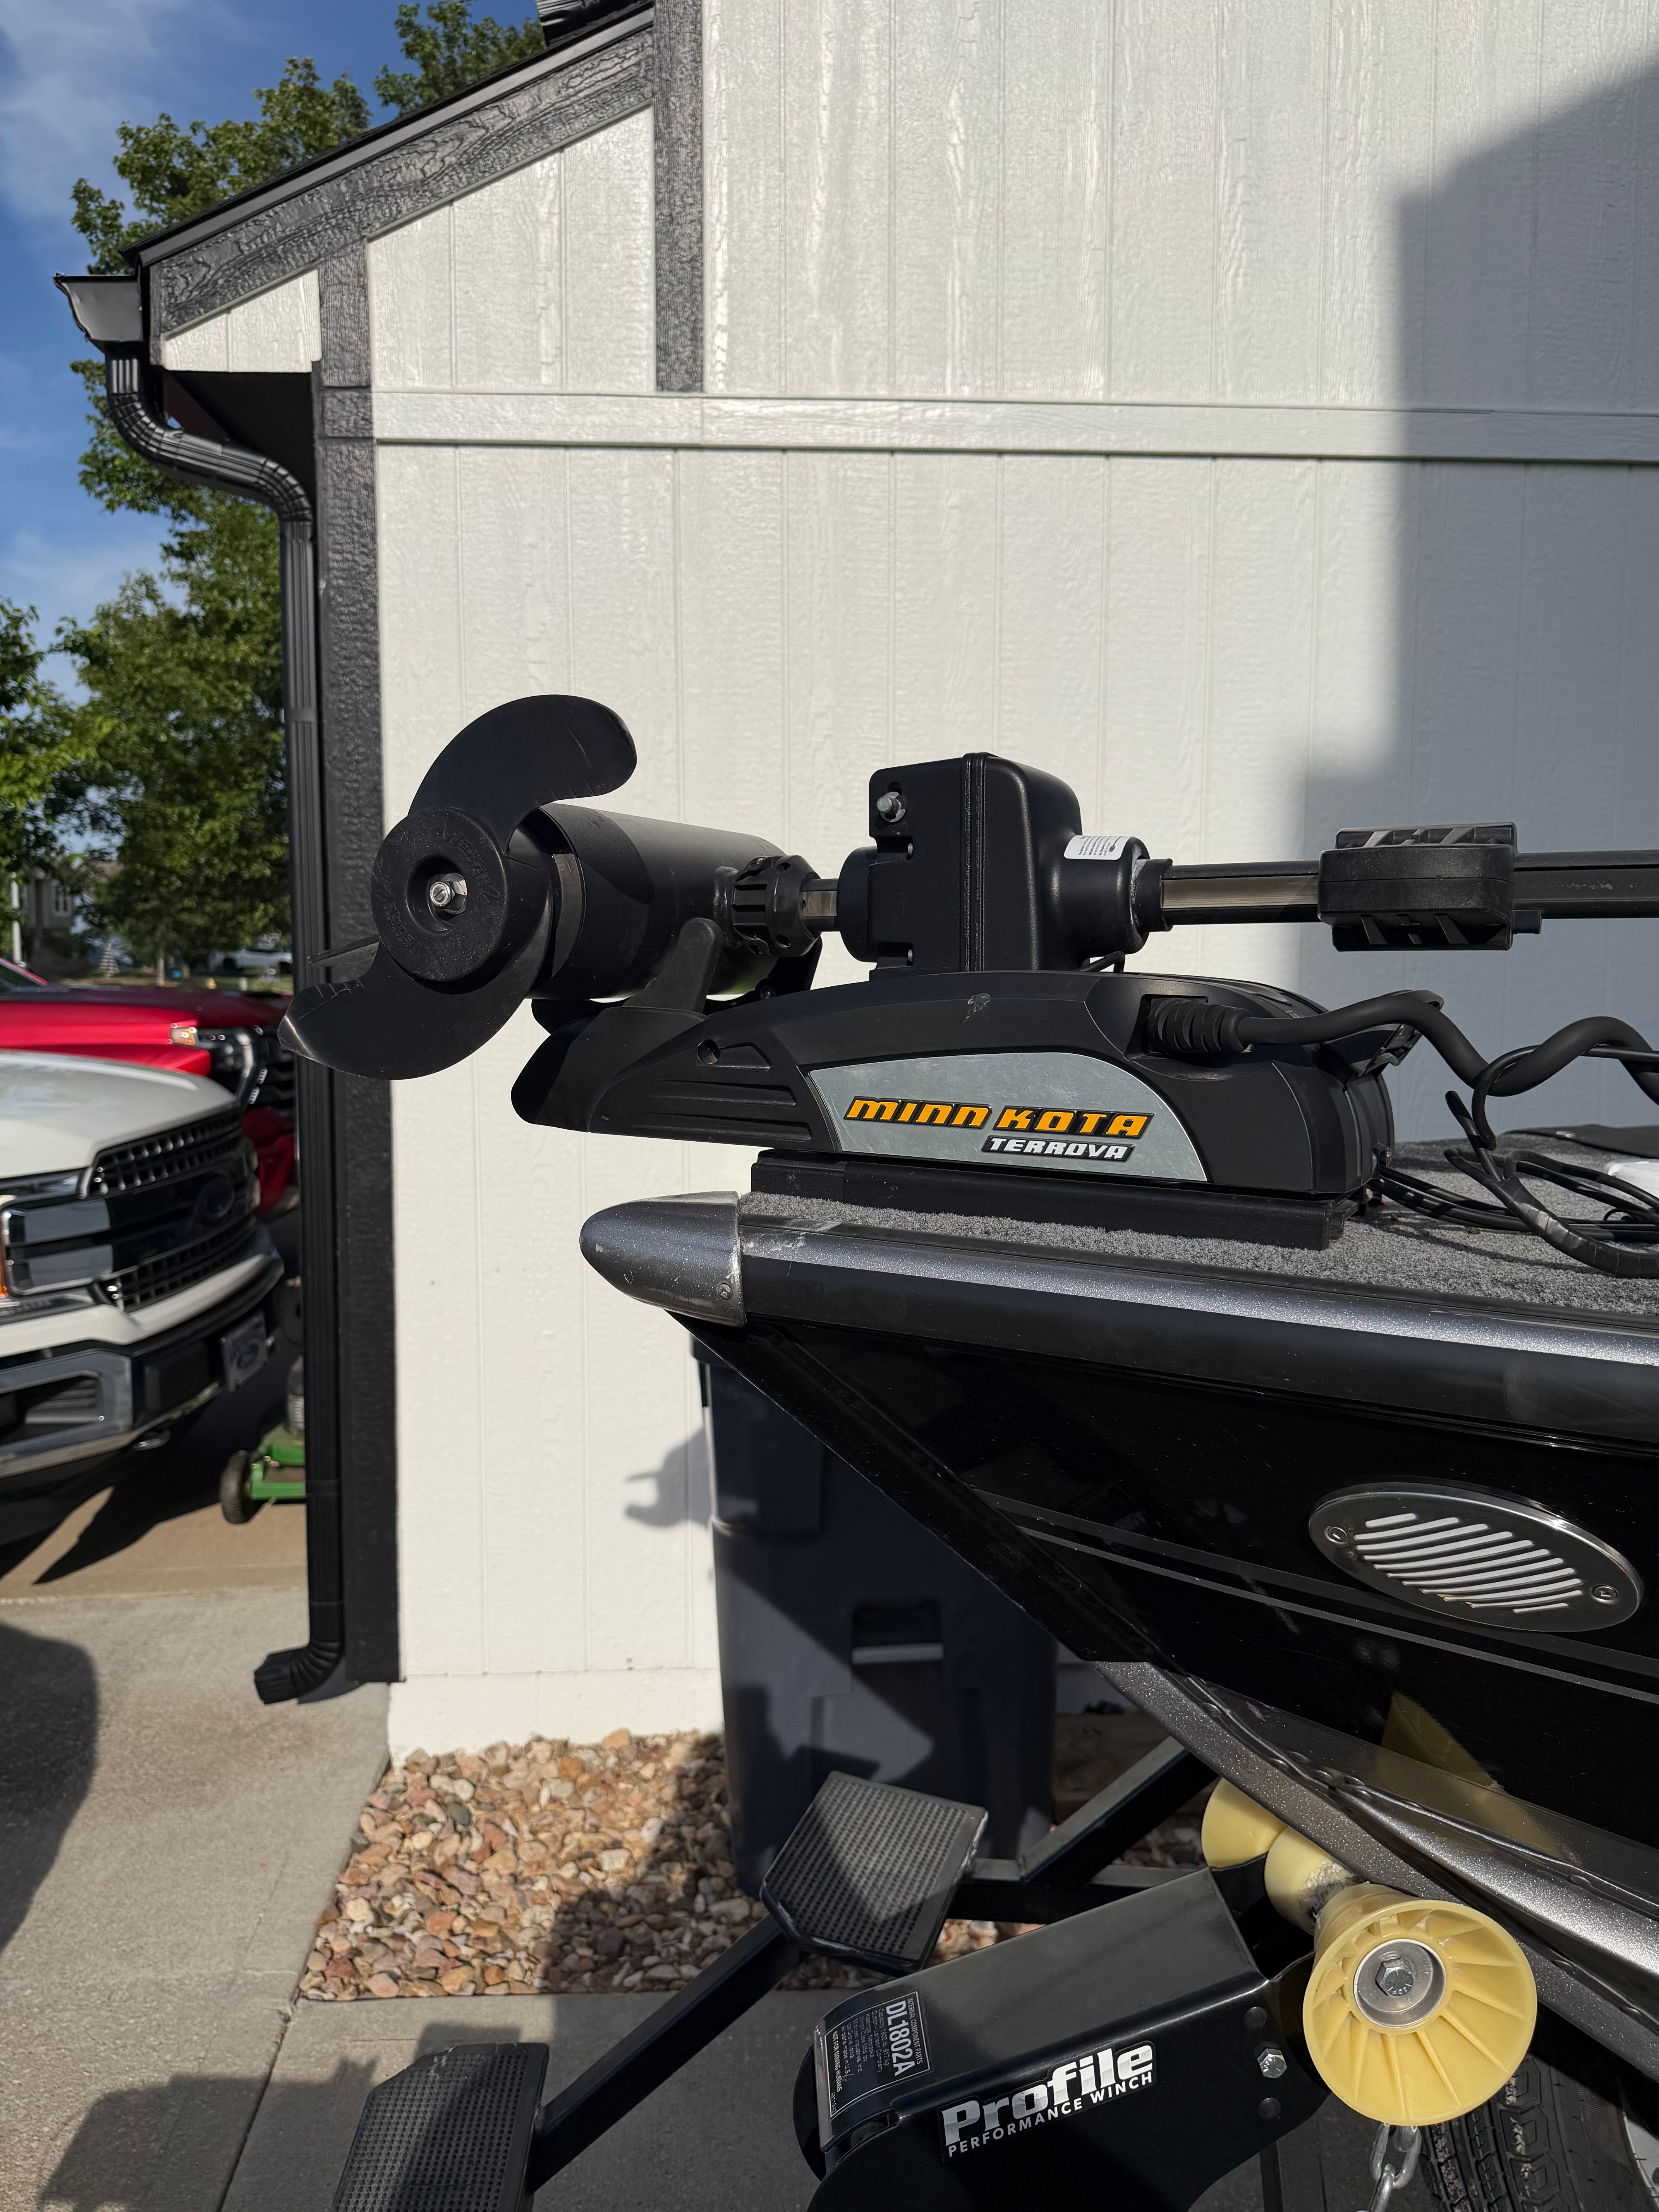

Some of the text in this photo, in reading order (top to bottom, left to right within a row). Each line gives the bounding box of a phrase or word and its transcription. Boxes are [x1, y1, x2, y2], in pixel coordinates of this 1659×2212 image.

[847, 1099, 1148, 1136] MINN KOTA
[990, 1137, 1128, 1159] TERROVA
[886, 2000, 915, 2076] DL1802A
[907, 1997, 923, 2065] INTERNAL COMPONENT PARTS
[835, 2069, 843, 2092] HUMANS
[874, 2047, 884, 2074] Company
[941, 2045, 1153, 2146] Profile
[948, 2071, 1152, 2157] PERFORMANCE WINCH
